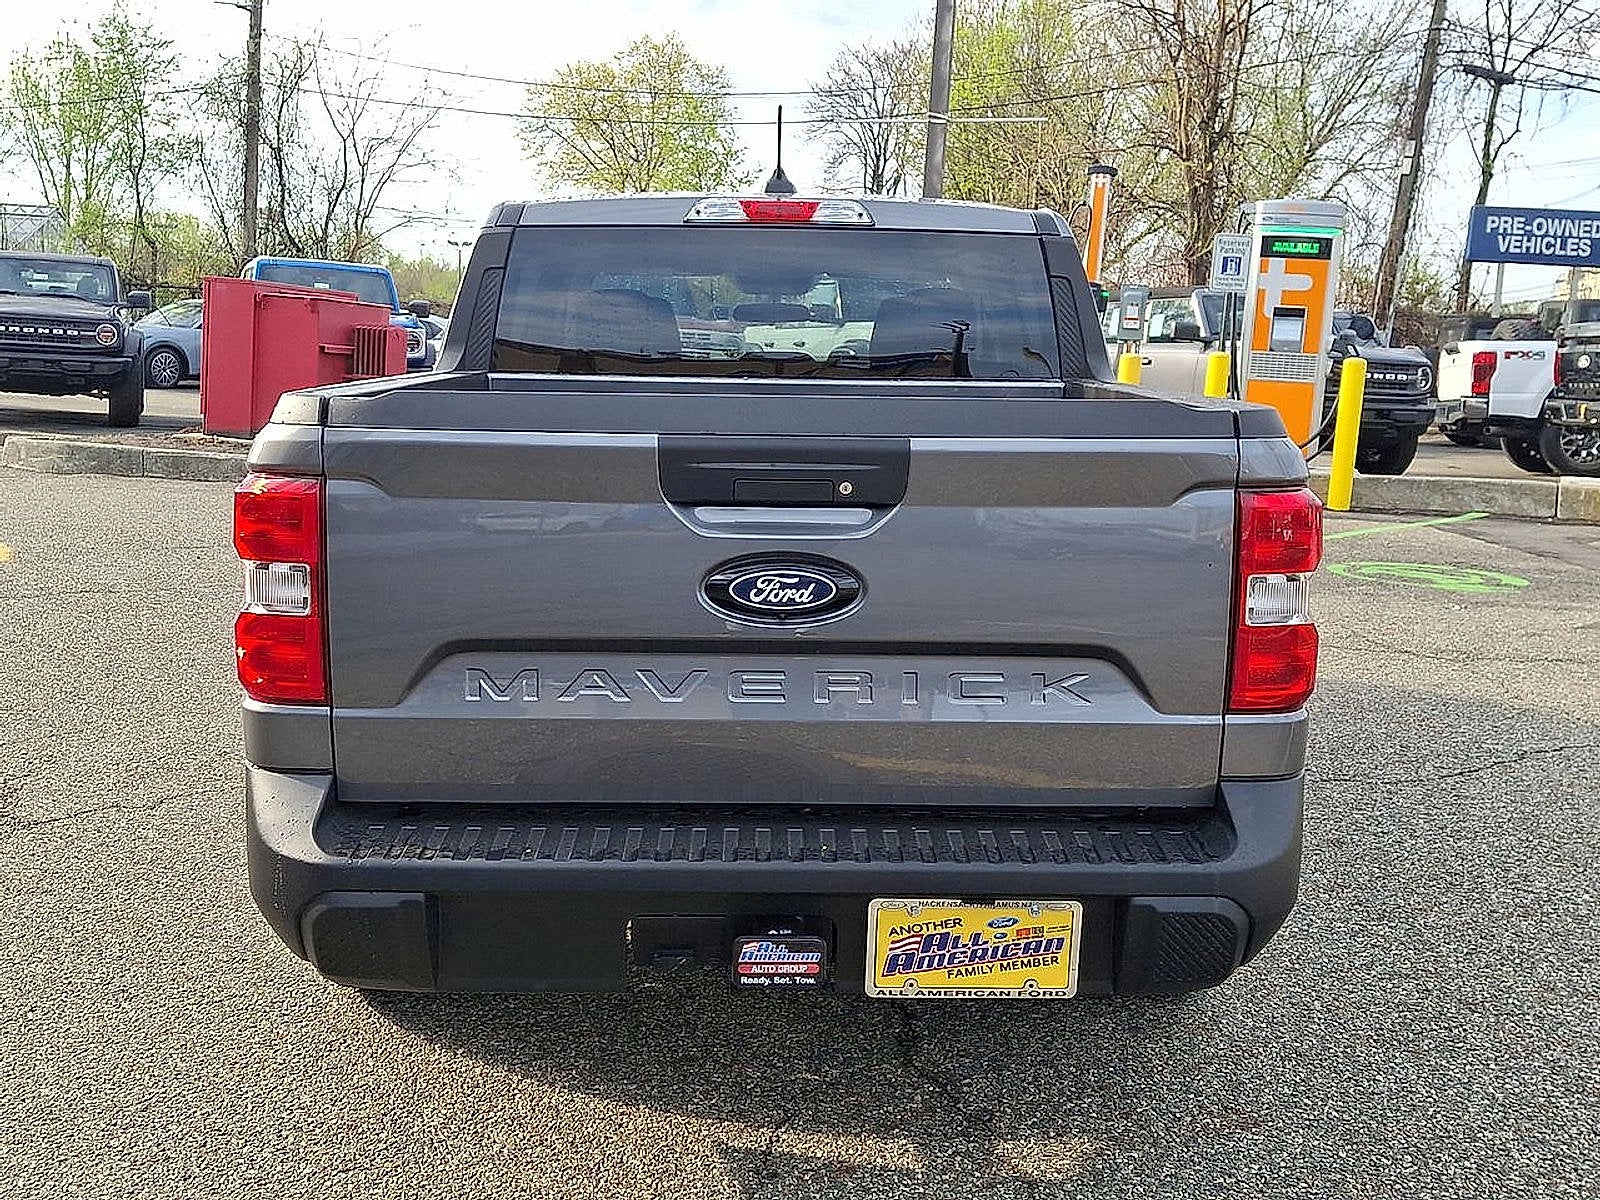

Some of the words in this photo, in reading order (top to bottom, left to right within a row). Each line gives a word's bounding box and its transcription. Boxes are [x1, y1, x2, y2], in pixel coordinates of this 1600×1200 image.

[1486, 215, 1600, 239] PRE-OWNED
[1497, 235, 1592, 258] VEHICLES
[750, 576, 813, 603] Ford
[465, 667, 1092, 705] MAVERICK
[888, 917, 964, 937] ANOTHER
[990, 916, 1016, 928] Ford
[751, 964, 776, 973] AUTO
[778, 964, 808, 973] GROUP
[947, 964, 995, 979] FAMILY
[1000, 956, 1060, 972] MEMBER
[740, 976, 772, 985] Ready.
[773, 976, 793, 984] Set.
[794, 976, 817, 984] Tow.
